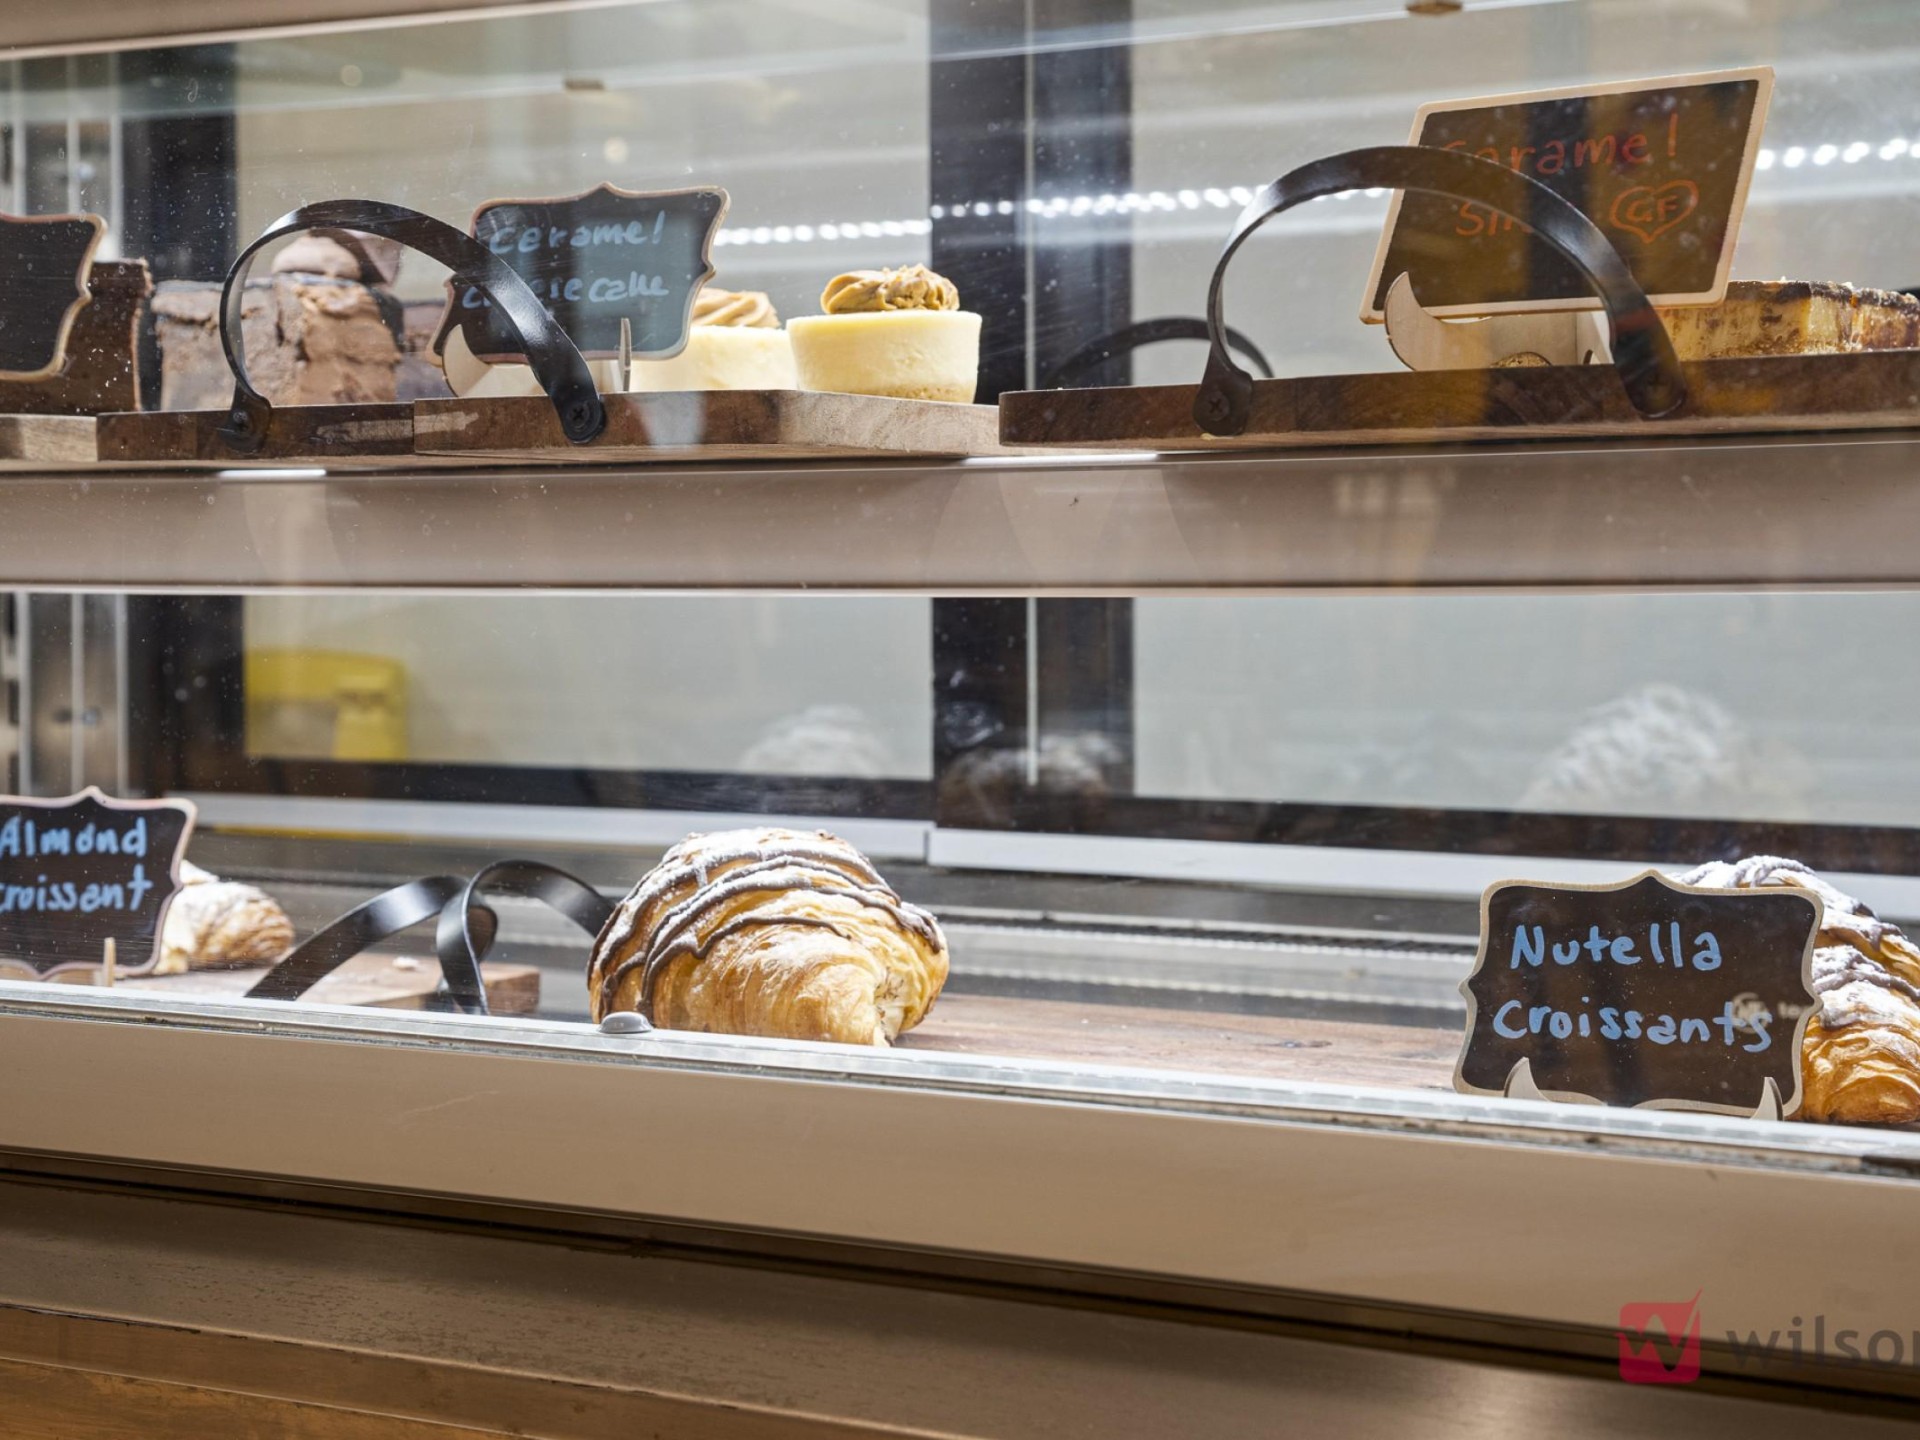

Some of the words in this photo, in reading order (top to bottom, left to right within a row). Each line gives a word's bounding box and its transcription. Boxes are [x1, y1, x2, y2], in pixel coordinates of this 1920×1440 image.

[0, 815, 147, 858] Almond
[1510, 921, 1722, 971] Nutella
[1493, 996, 1773, 1053] Croissants
